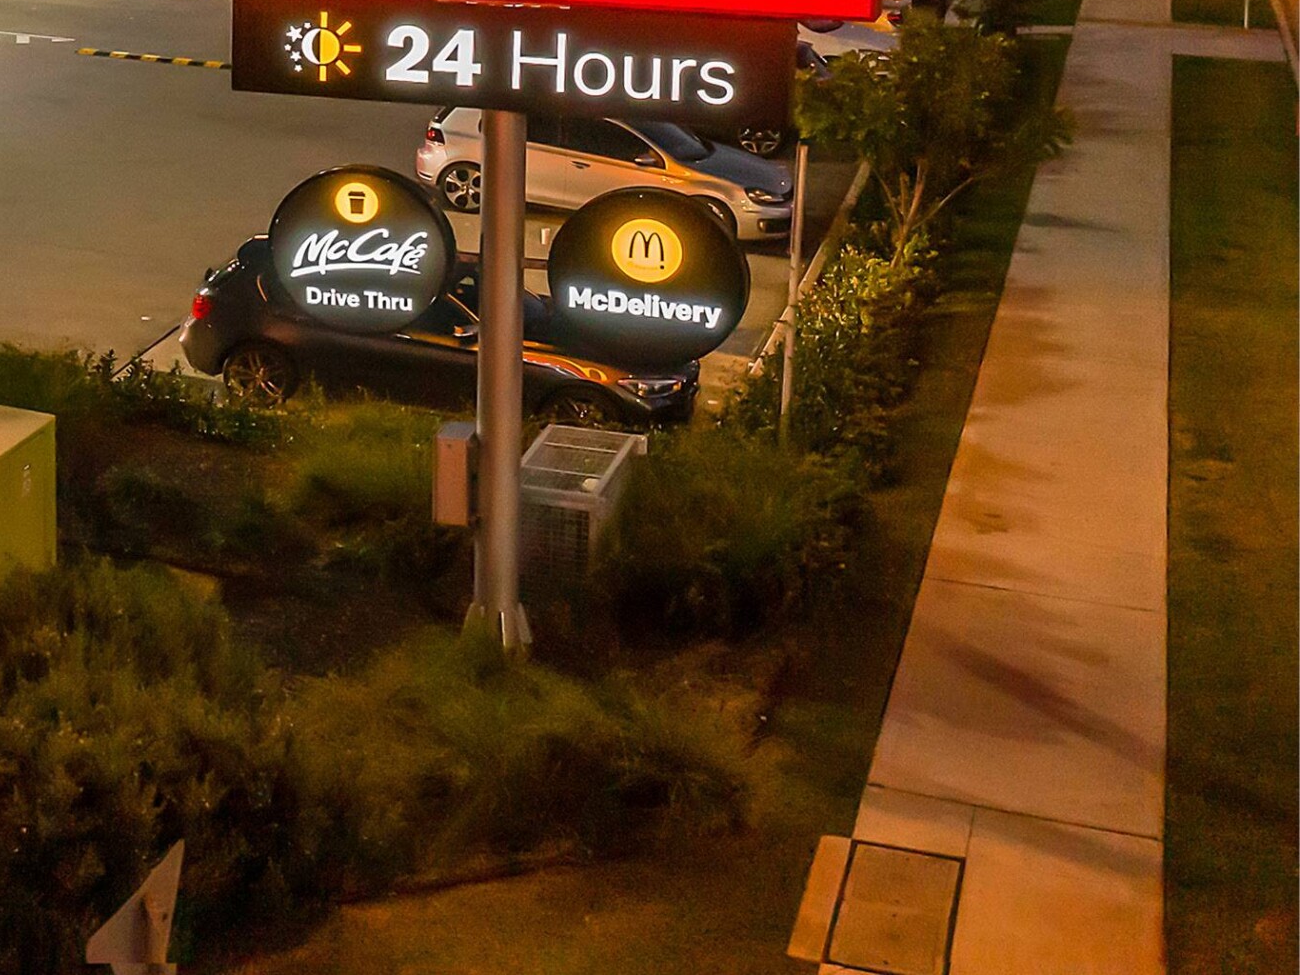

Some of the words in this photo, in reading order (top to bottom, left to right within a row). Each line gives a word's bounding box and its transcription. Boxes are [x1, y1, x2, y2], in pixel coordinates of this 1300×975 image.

[385, 25, 481, 87] 24
[511, 30, 735, 105] Hours
[306, 286, 360, 307] Drive
[363, 290, 413, 311] Thru
[568, 286, 722, 329] McDelivery
